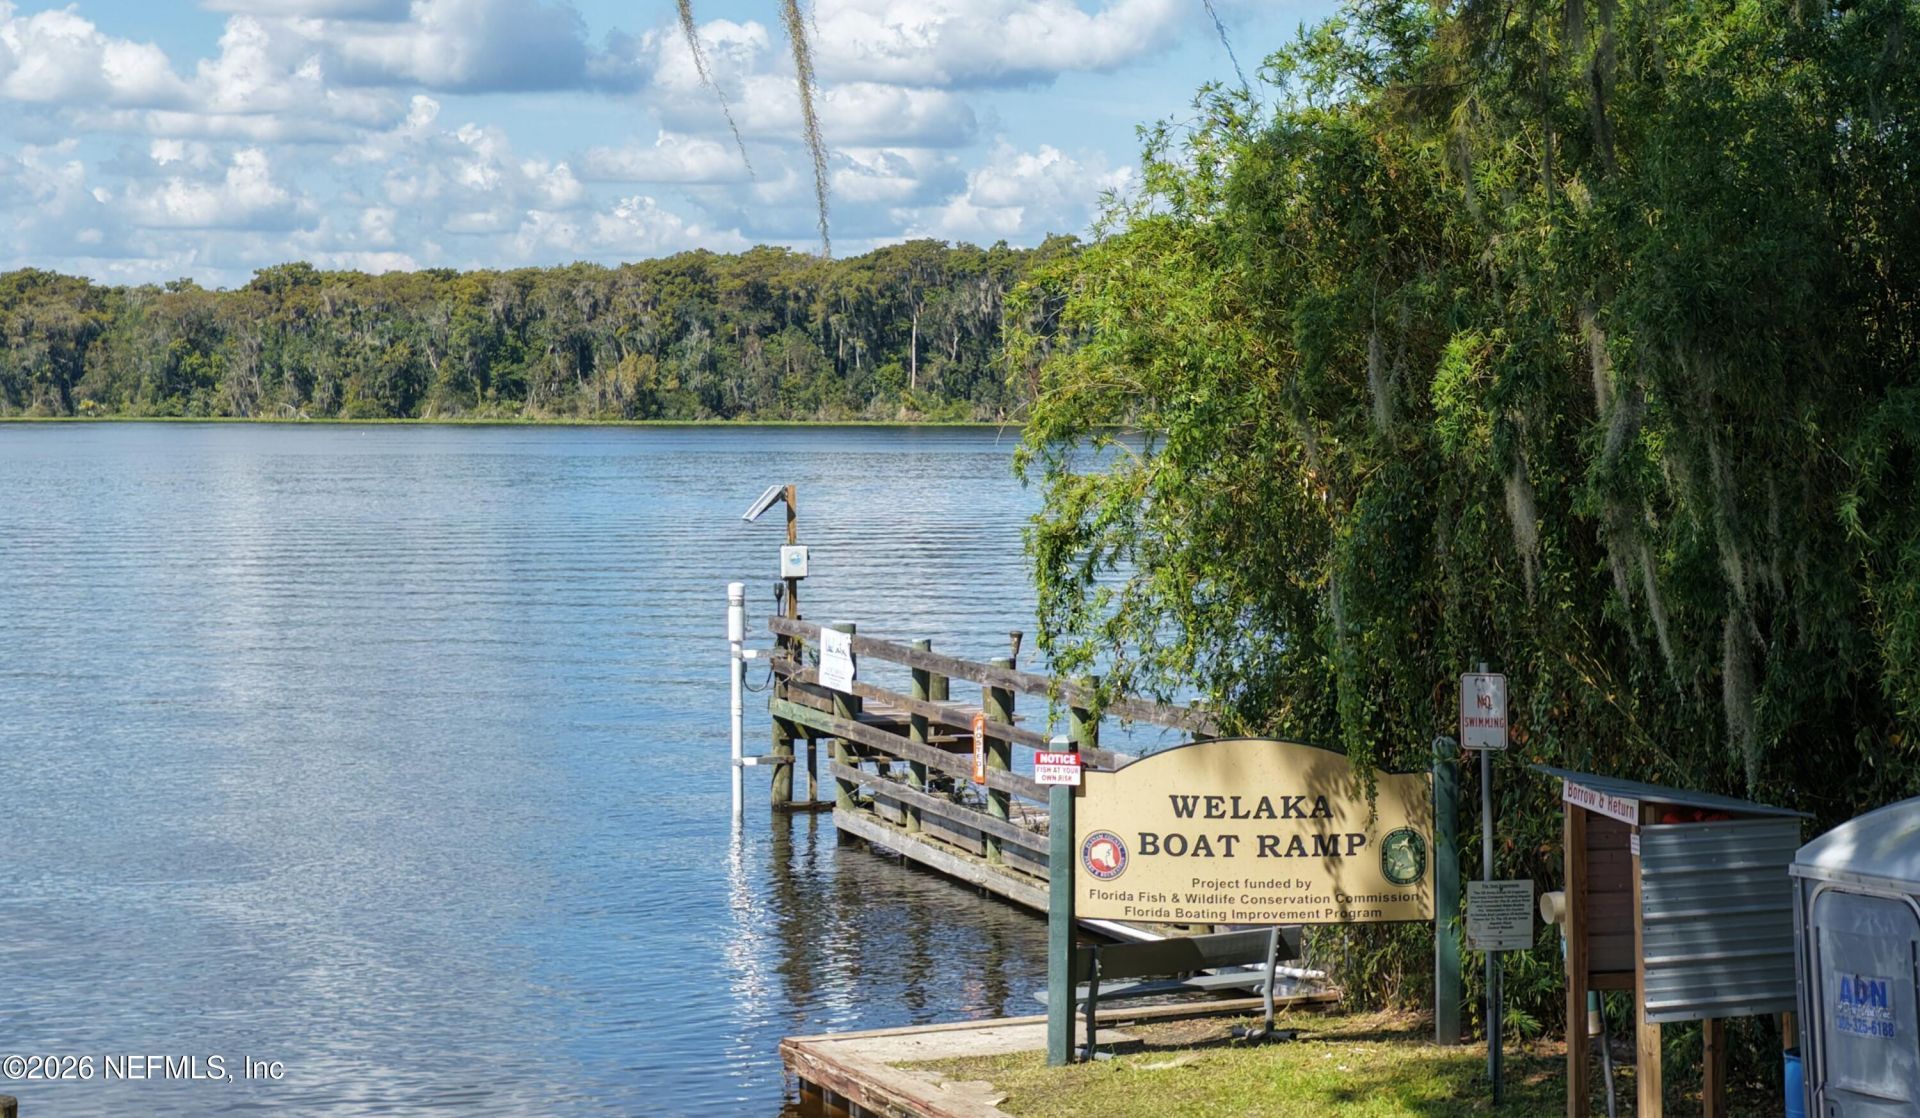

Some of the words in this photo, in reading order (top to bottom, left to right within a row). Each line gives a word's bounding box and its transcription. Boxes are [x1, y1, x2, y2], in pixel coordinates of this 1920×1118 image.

[1476, 694, 1491, 709] NO
[1464, 717, 1506, 728] SWIMMING
[1040, 753, 1076, 765] NOTICE
[1168, 795, 1334, 819] WELAKA
[1567, 782, 1596, 806] Borrow
[1608, 795, 1635, 820] Return
[1138, 832, 1240, 858] BOAT
[1257, 833, 1367, 858] RAMP
[1192, 878, 1239, 891] Project
[1244, 878, 1291, 889] funded
[1296, 878, 1312, 891] by
[1089, 889, 1134, 901] Florida
[1139, 892, 1167, 903] Fish
[1171, 893, 1180, 904] &
[1185, 894, 1236, 905] Wildlife
[1240, 894, 1330, 905] Conservation
[1336, 892, 1419, 904] Commission
[1124, 906, 1170, 918] Florida
[1176, 908, 1227, 922] Boating
[1232, 909, 1320, 921] Improvement
[1325, 908, 1382, 921] Program
[1840, 976, 1887, 1009] ADN
[1838, 1014, 1894, 1037] -325-6188
